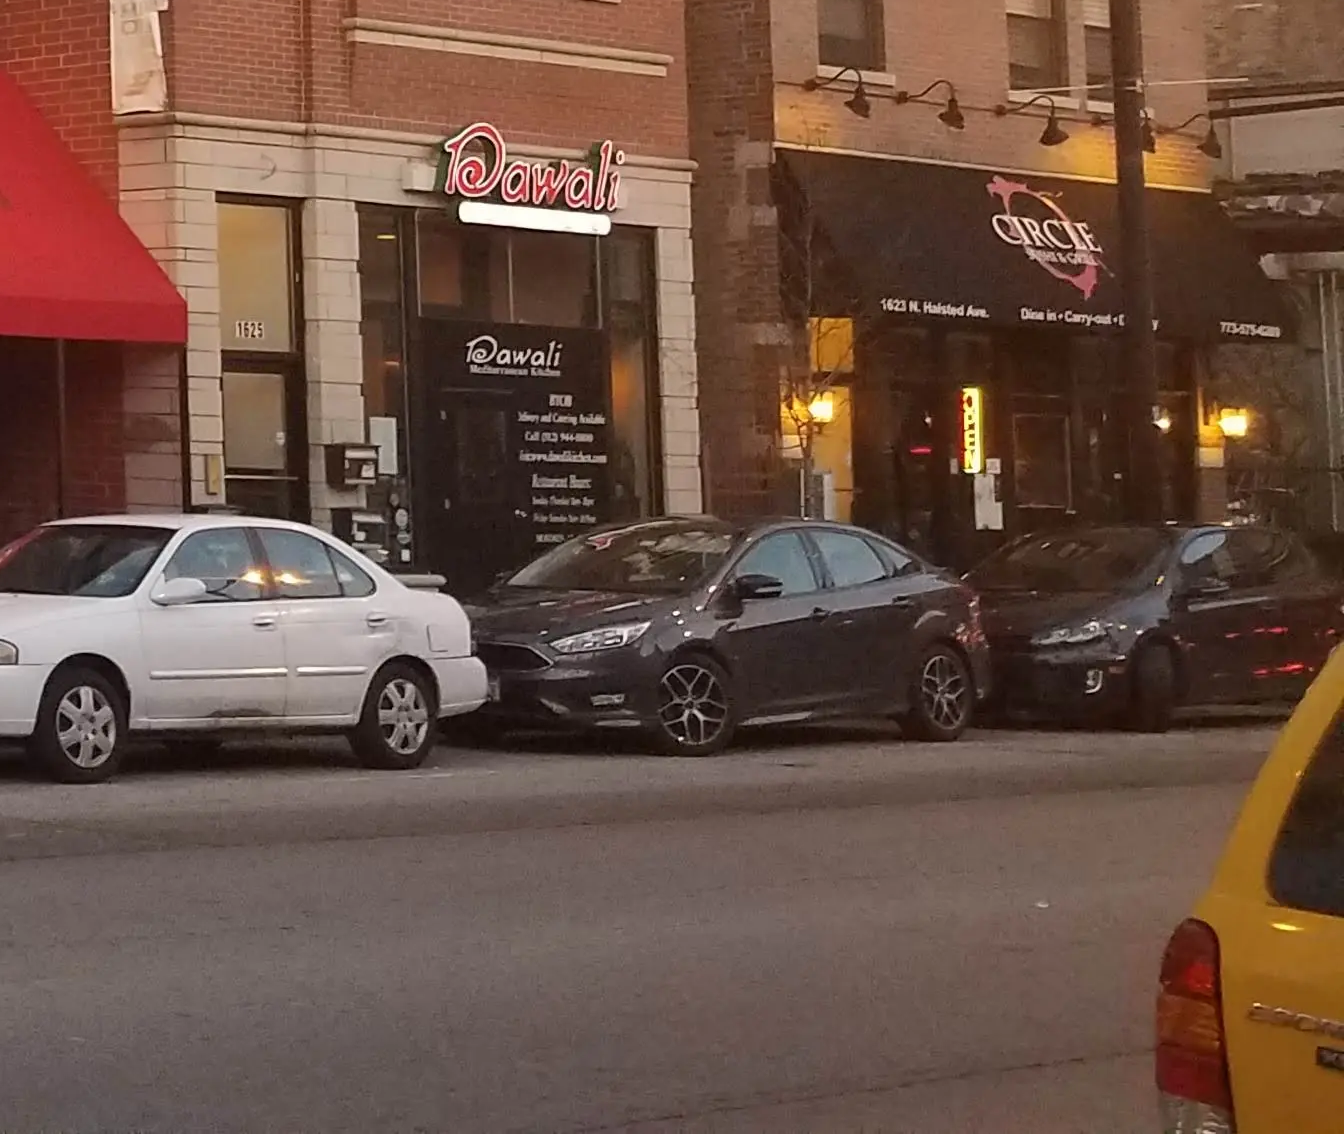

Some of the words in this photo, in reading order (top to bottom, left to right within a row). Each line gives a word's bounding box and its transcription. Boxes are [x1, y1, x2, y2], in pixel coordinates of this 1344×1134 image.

[444, 122, 626, 211] Dawali
[991, 213, 1103, 254] CIRCLE
[880, 298, 906, 312] 1623
[909, 300, 921, 313] N.
[923, 301, 964, 317] Halsted
[966, 305, 990, 318] Ave.
[1020, 307, 1044, 320] Dine
[1046, 309, 1057, 321] in
[237, 321, 263, 338] 1625
[465, 335, 563, 366] Dawali
[470, 364, 528, 375] Mediterranean
[530, 366, 560, 377] Kitchen
[525, 430, 540, 442] Call
